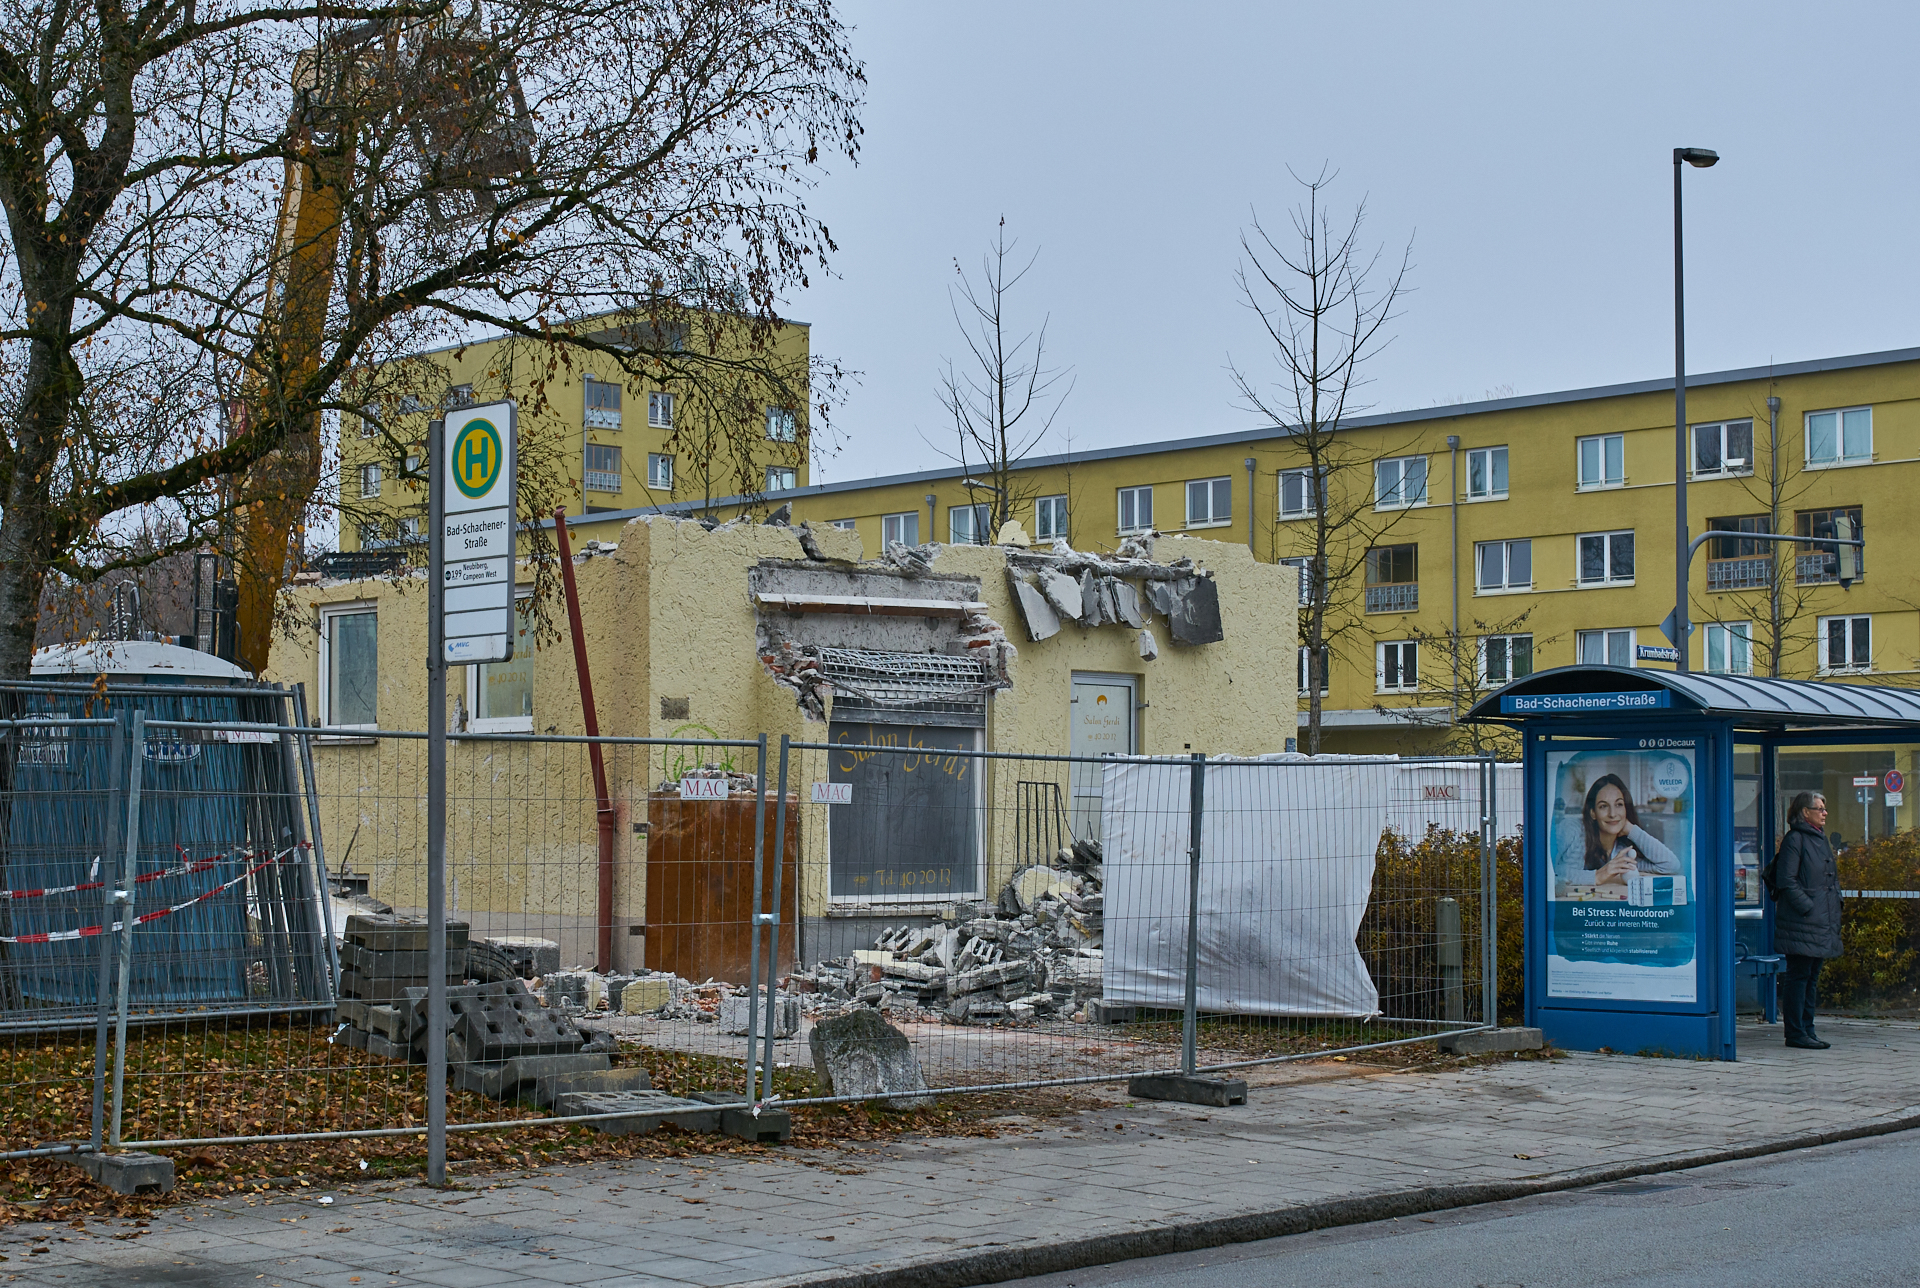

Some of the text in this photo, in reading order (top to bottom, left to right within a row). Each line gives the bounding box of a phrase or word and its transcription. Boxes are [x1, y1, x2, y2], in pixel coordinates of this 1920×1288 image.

[466, 437, 488, 480] H
[446, 520, 506, 537] Bad-Schachener-
[464, 536, 488, 549] Straße
[463, 562, 489, 571] Neubiberg,
[451, 570, 462, 578] 199
[463, 570, 498, 581] Campeon West
[1639, 646, 1679, 661] Krumbadstraße
[1515, 694, 1656, 709] Bad-Schachener-Straße
[1084, 715, 1120, 728] Salon Gerdi
[1667, 739, 1696, 747] Decaux
[838, 724, 969, 780] Salon Gerdi
[685, 780, 725, 796] MAC
[817, 784, 850, 800] MAC
[1425, 786, 1454, 798] MAC
[876, 869, 896, 886] Tel.
[899, 871, 916, 889] 40
[920, 869, 936, 884] 20
[1572, 907, 1586, 917] Bei
[1587, 908, 1617, 917] Stress:
[1584, 919, 1606, 927] Zurück
[1618, 920, 1641, 928] inneren
[1641, 920, 1660, 928] Mitte.
